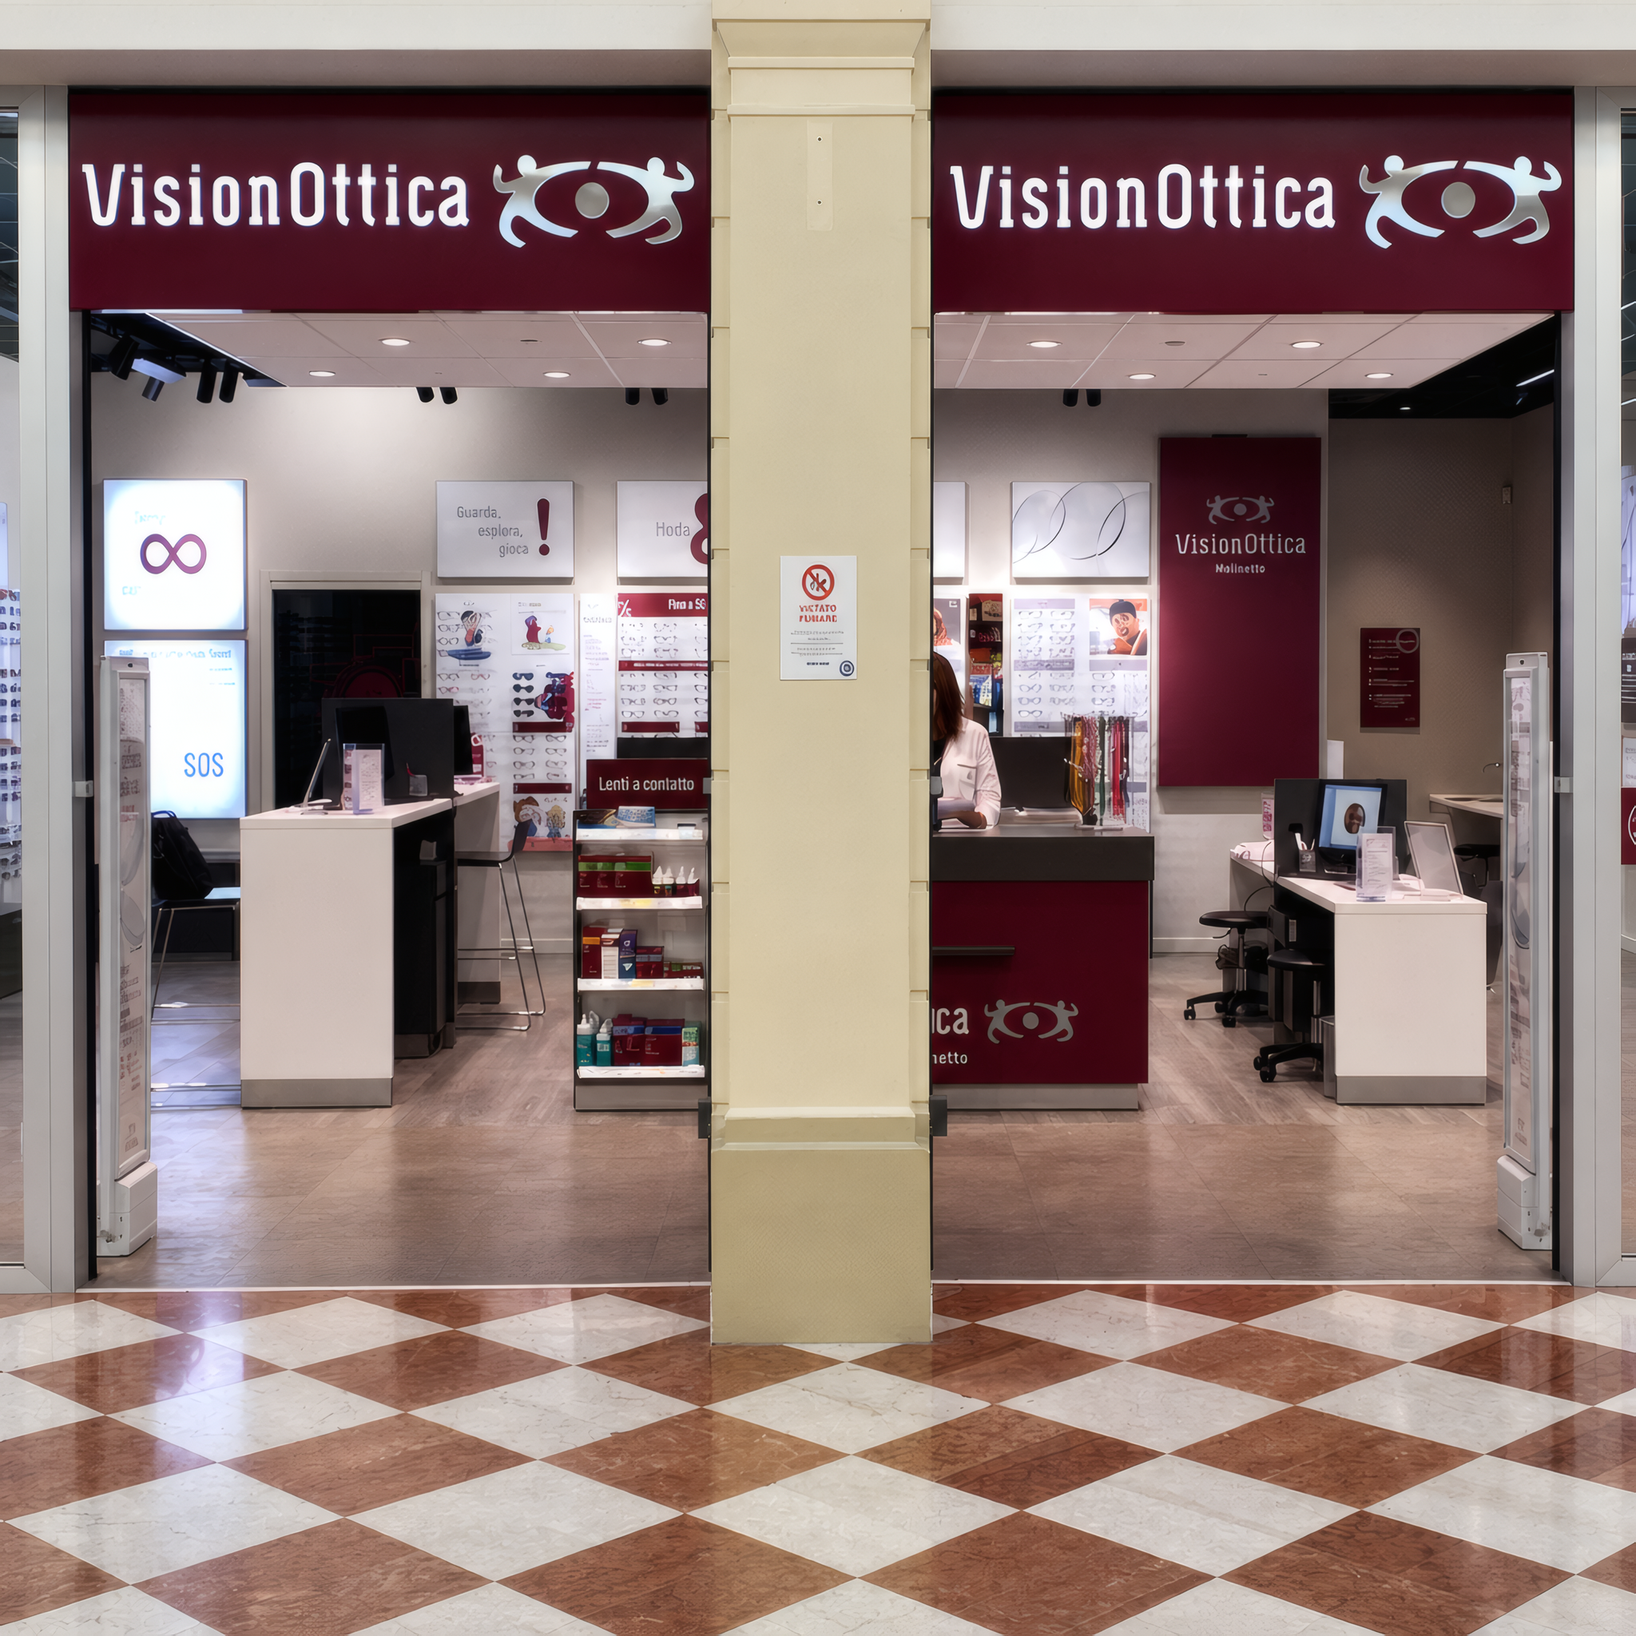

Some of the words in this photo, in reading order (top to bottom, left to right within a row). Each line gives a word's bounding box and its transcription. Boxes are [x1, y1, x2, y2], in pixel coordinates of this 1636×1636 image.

[82, 161, 470, 227] VisionOttica
[950, 163, 1336, 229] VisionOttica
[478, 523, 523, 540] esplora,
[498, 542, 529, 558] gioca
[1175, 533, 1306, 554] VisionOttica
[183, 752, 224, 778] SOS
[599, 776, 630, 791] Lenti
[632, 779, 640, 791] a
